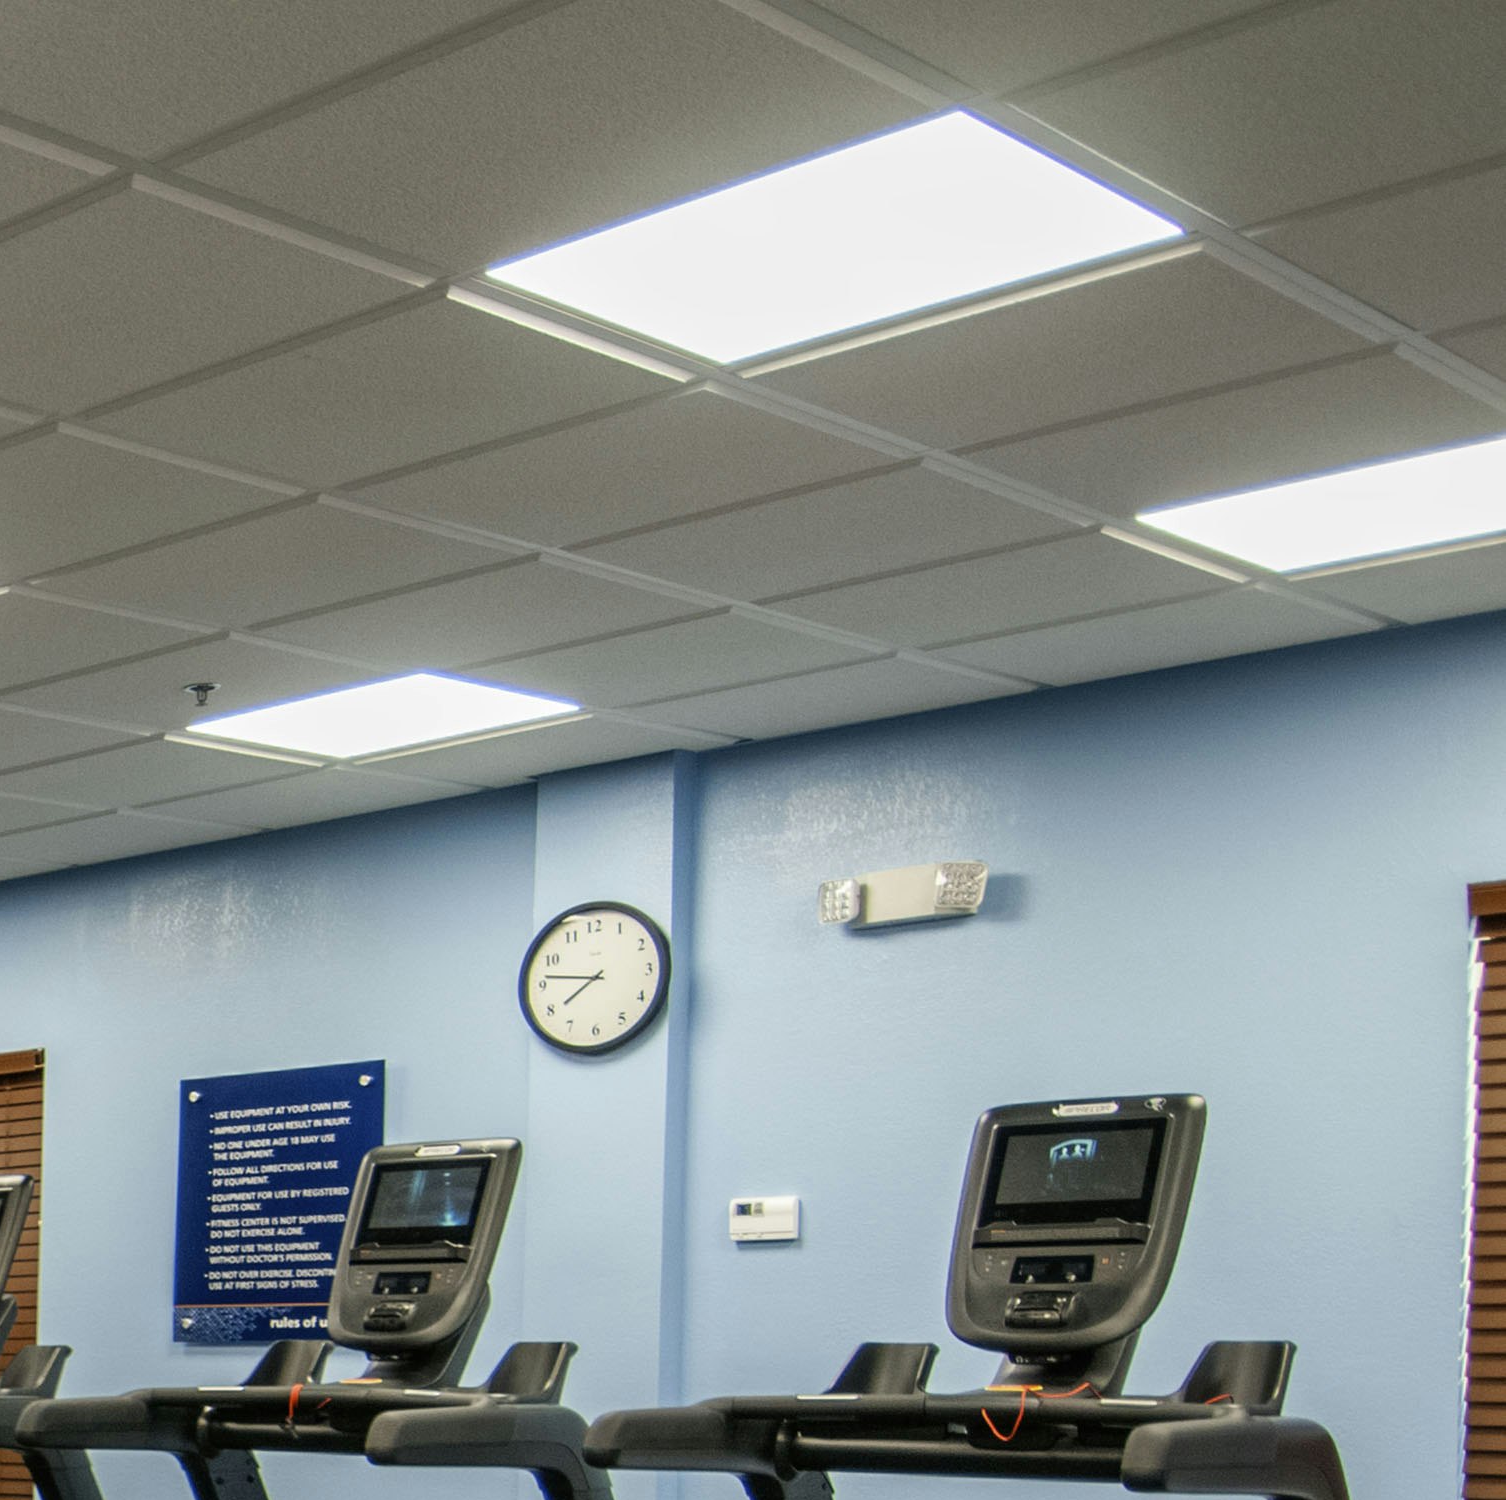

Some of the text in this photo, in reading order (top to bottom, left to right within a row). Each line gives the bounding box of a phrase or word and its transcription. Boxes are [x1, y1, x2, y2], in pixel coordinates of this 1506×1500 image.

[587, 920, 601, 933] 12
[618, 923, 622, 934] 1
[566, 931, 577, 943] 11
[638, 939, 645, 950] 2
[546, 954, 559, 966] 10
[645, 963, 652, 976] 3
[539, 980, 546, 991] 9
[637, 990, 644, 1002] 4
[547, 1004, 555, 1016] 8
[618, 1012, 626, 1025] 5
[566, 1020, 573, 1032] 7
[592, 1025, 600, 1036] 6
[215, 1101, 352, 1119] USE EQUIPMENT AT YOUR OWN RISK.
[214, 1117, 351, 1135] IMPROPER USE CAN RESULT IN INJURY.
[214, 1142, 226, 1150] NO
[227, 1141, 243, 1149] ONE
[245, 1139, 271, 1148] UNDER
[272, 1137, 288, 1146] AGE
[301, 1135, 319, 1144] MAY
[321, 1134, 335, 1142] USE
[230, 1149, 274, 1160] EQUIPMENT.
[213, 1161, 338, 1176] FOLLOW ALL DIRECTIONS FOR USE
[212, 1176, 269, 1186] OF EQUIPMENT.
[212, 1187, 349, 1202] EQUIPMENT FOR USE BY REGISTERED
[211, 1204, 239, 1212] GUESTS
[211, 1214, 346, 1227] FITNESS CENTER IS NOT SUPERVISED.
[224, 1229, 240, 1238] NOT
[242, 1228, 275, 1237] EXERCISE
[277, 1227, 305, 1236] ALONE.
[210, 1242, 320, 1253] DO NOT USE THIS EQUIPMENT
[209, 1255, 245, 1264] WITHOUT
[222, 1271, 238, 1279] NOT
[240, 1271, 258, 1279] OVER
[209, 1282, 223, 1290] USE
[235, 1281, 255, 1289] FIRST
[256, 1281, 277, 1289] SIGNS
[292, 1280, 319, 1288] STRESS.
[270, 1317, 300, 1328] rules
[303, 1316, 316, 1328] of
